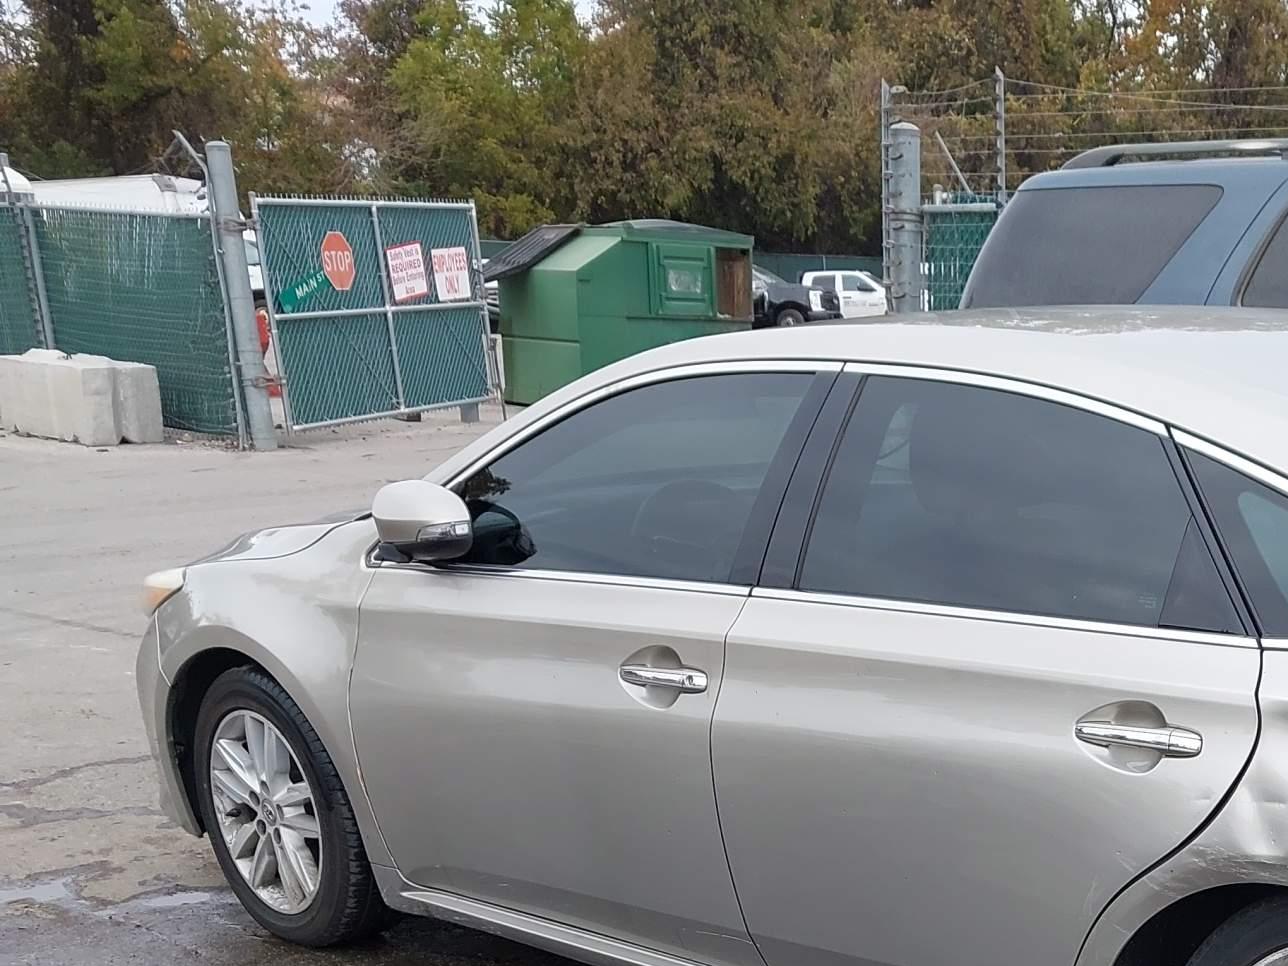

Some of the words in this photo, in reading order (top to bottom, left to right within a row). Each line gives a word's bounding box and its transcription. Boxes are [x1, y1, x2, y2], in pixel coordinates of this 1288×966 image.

[324, 250, 351, 272] STOP
[391, 259, 421, 274] REQUIRED
[432, 252, 467, 273] EMPLOYEES
[295, 277, 318, 300] MAIN
[316, 271, 326, 282] ST
[445, 274, 460, 295] ONLY
